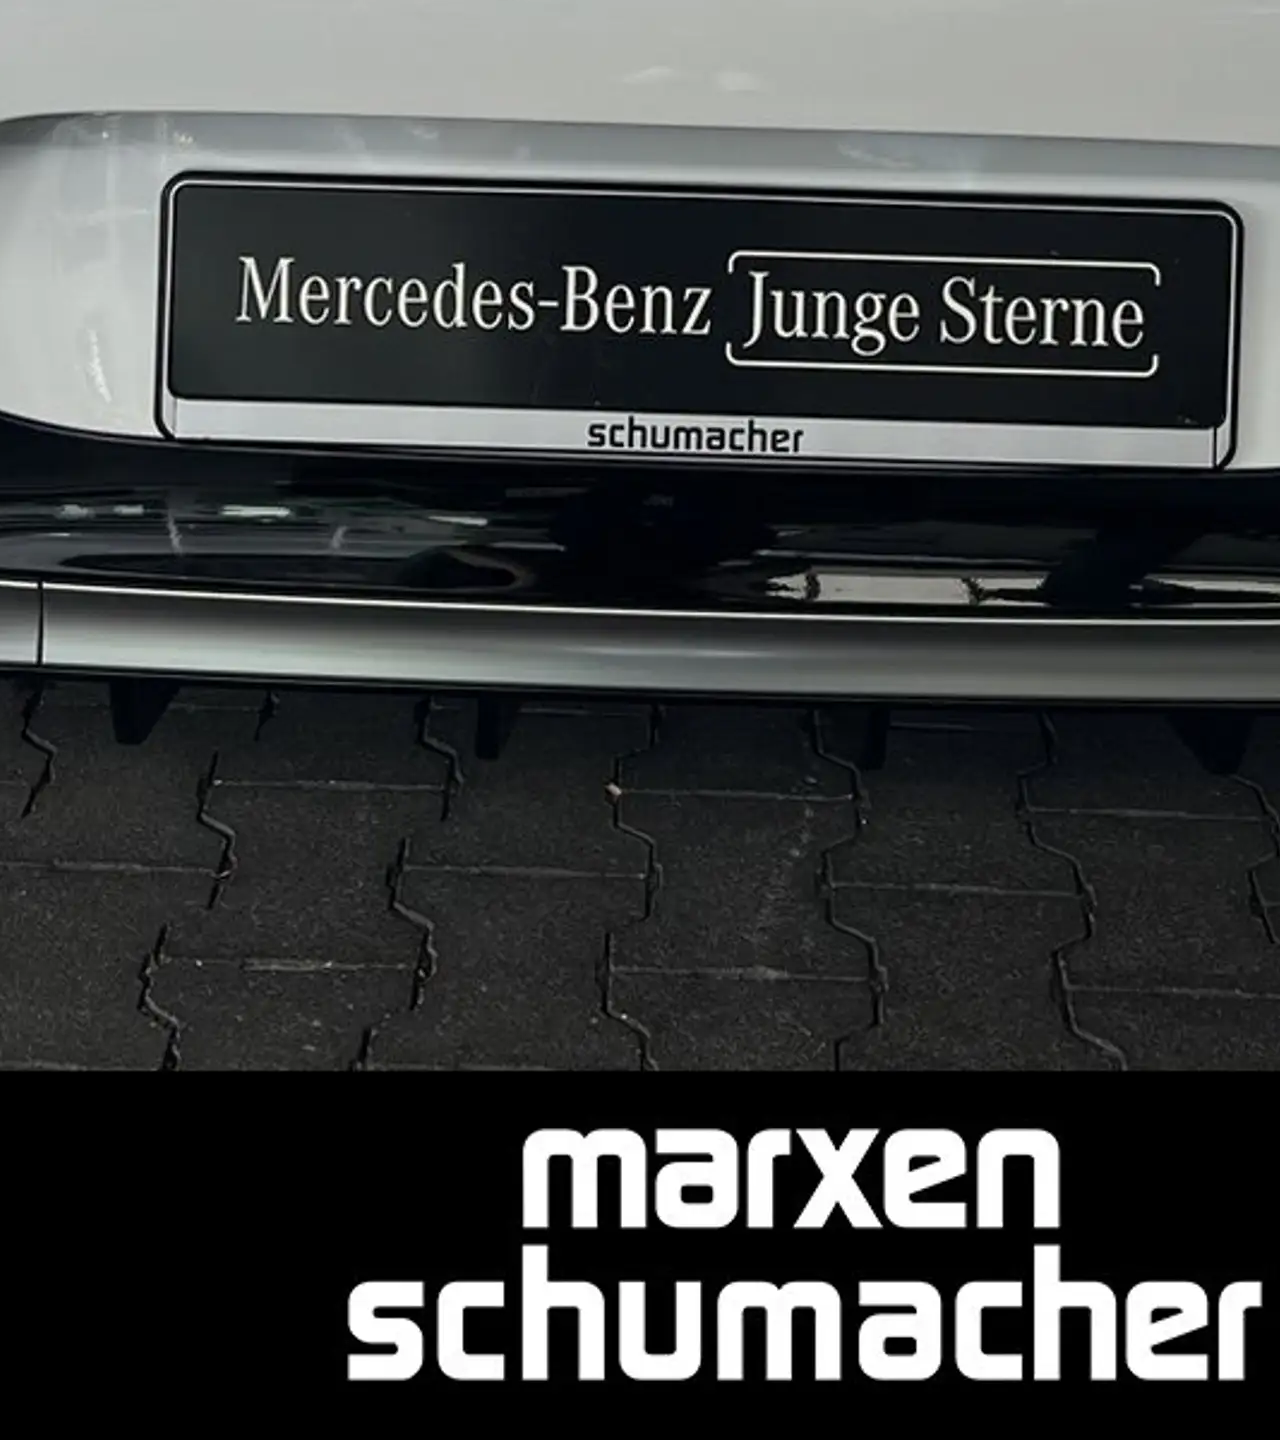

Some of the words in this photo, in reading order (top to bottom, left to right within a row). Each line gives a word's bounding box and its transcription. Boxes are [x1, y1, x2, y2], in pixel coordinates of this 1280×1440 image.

[234, 255, 712, 336] Mercedes-Benz
[742, 270, 921, 357] Junge
[939, 275, 1145, 349] Sterne
[586, 414, 805, 454] schumacher
